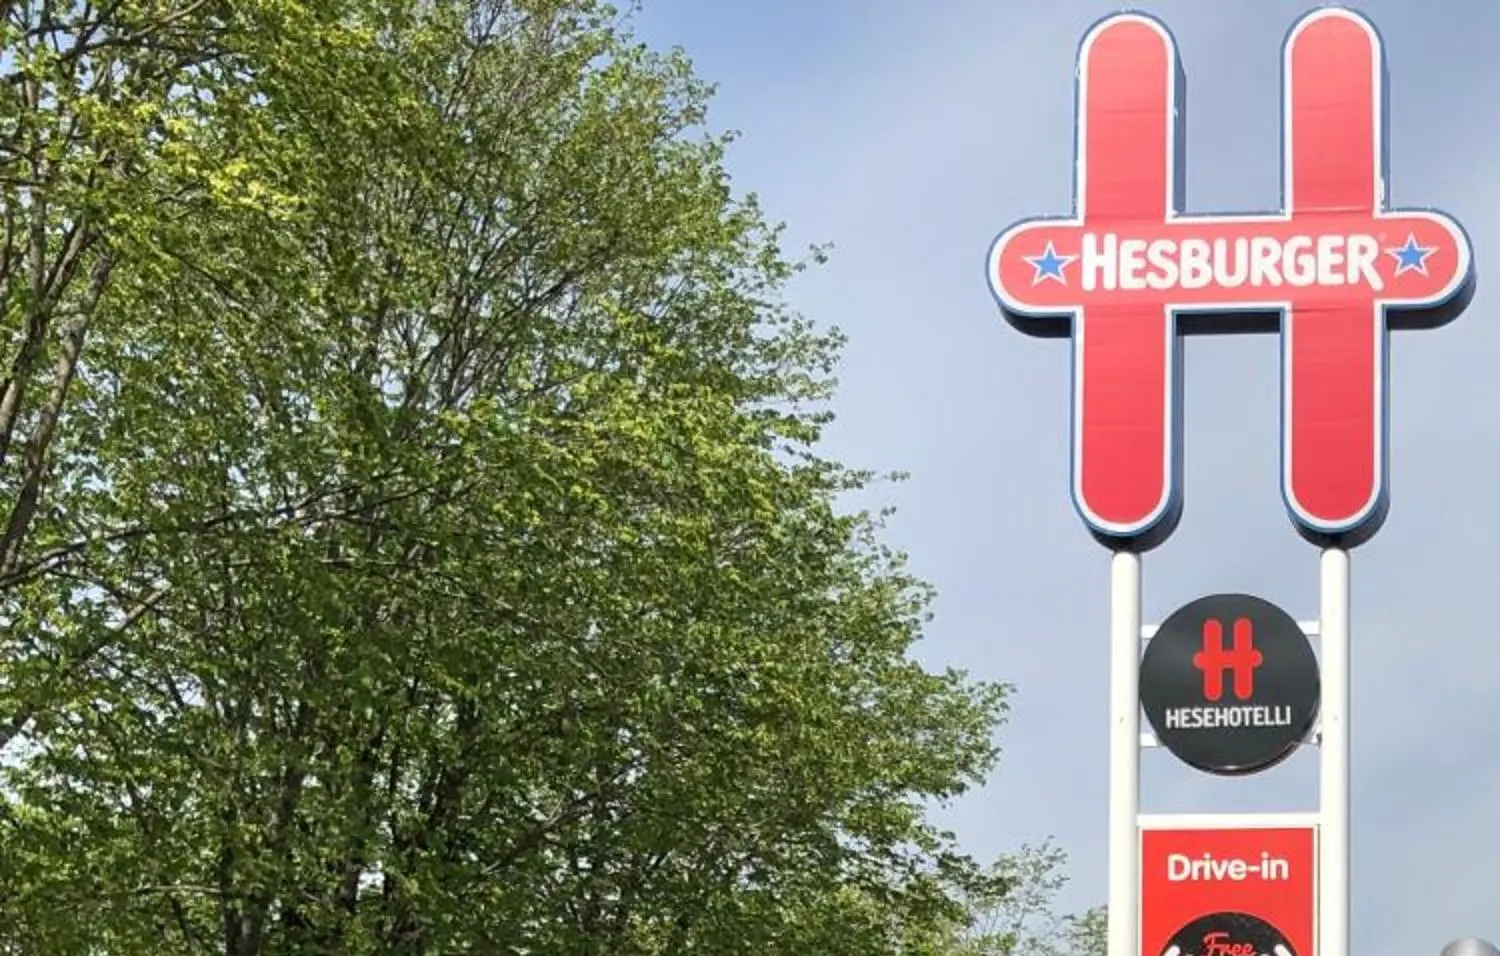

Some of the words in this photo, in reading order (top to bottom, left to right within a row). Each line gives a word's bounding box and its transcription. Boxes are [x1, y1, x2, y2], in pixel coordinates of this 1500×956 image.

[1081, 232, 1384, 292] HESBURGER
[1165, 705, 1292, 729] HESEHOTELLI
[1167, 851, 1289, 881] Drive-in
